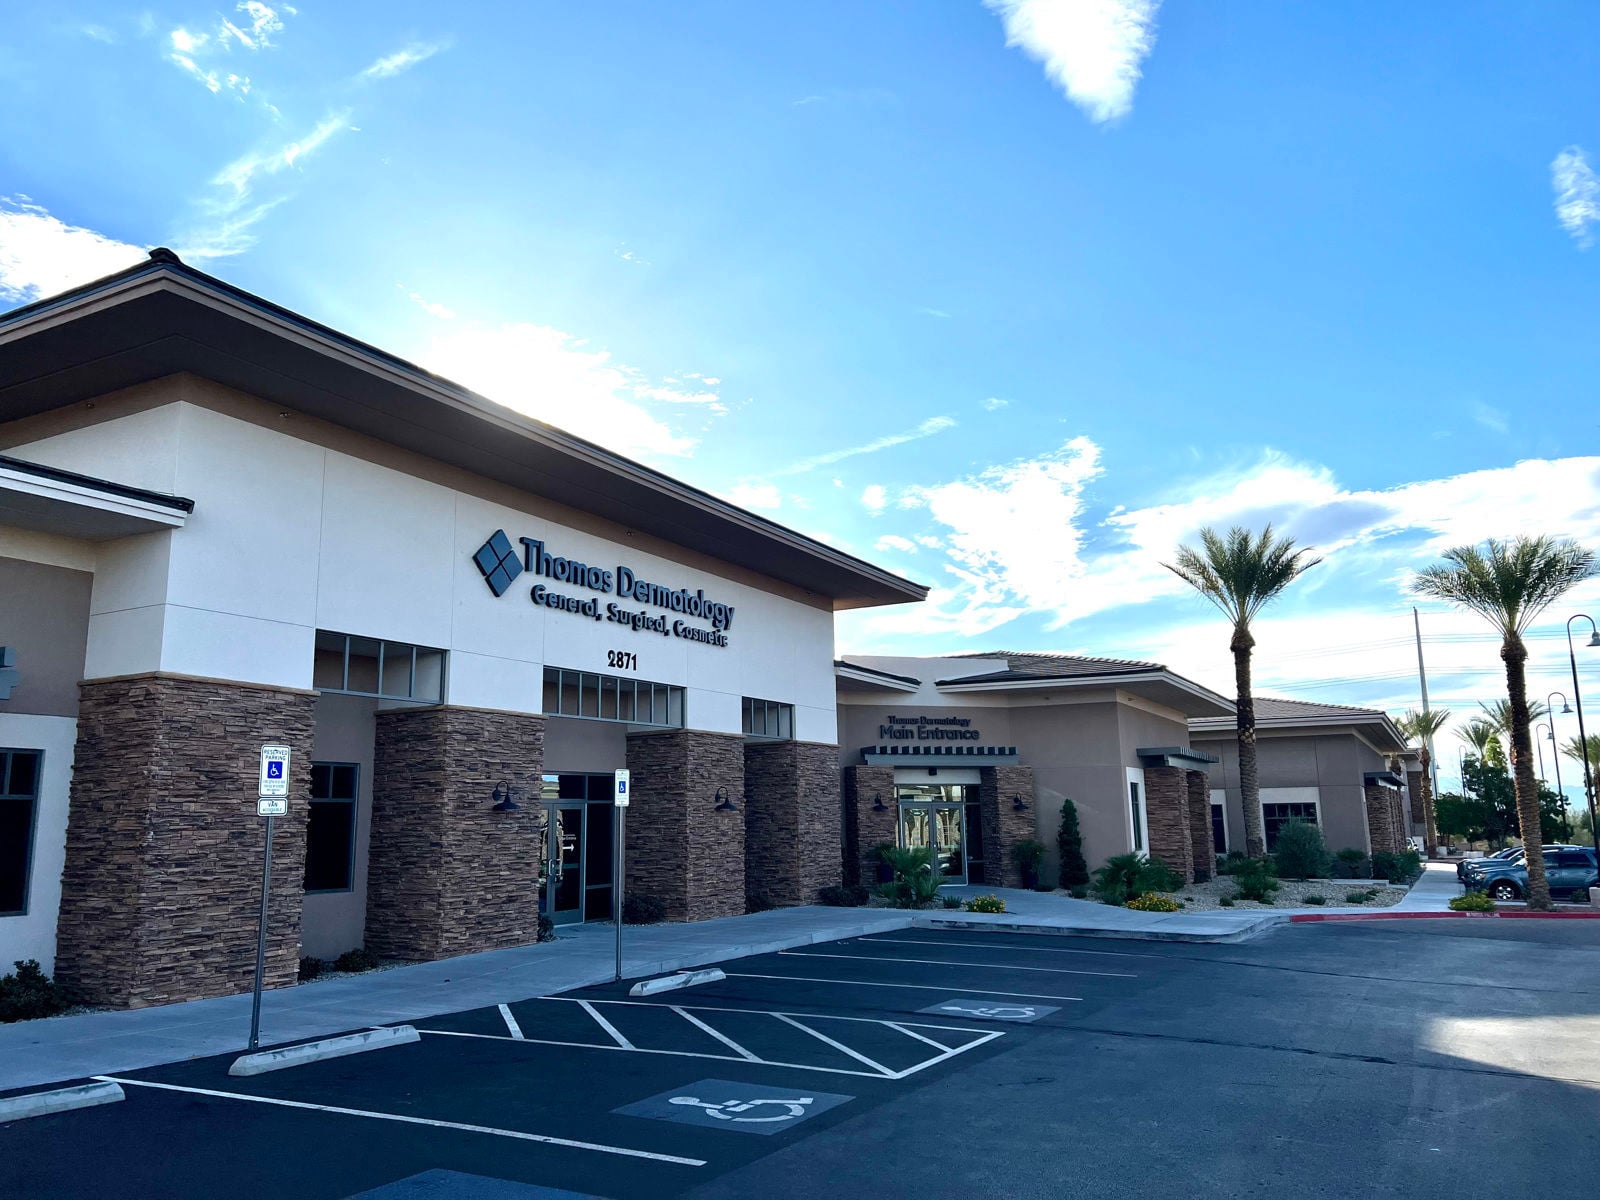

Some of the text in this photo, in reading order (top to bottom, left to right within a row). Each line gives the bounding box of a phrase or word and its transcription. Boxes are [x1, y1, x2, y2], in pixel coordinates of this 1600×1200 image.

[519, 536, 735, 630] Thomas Dermatology
[530, 583, 729, 647] General, Surgical, Cosmetic
[607, 650, 637, 671] 2871
[880, 725, 980, 741] Main Entrance
